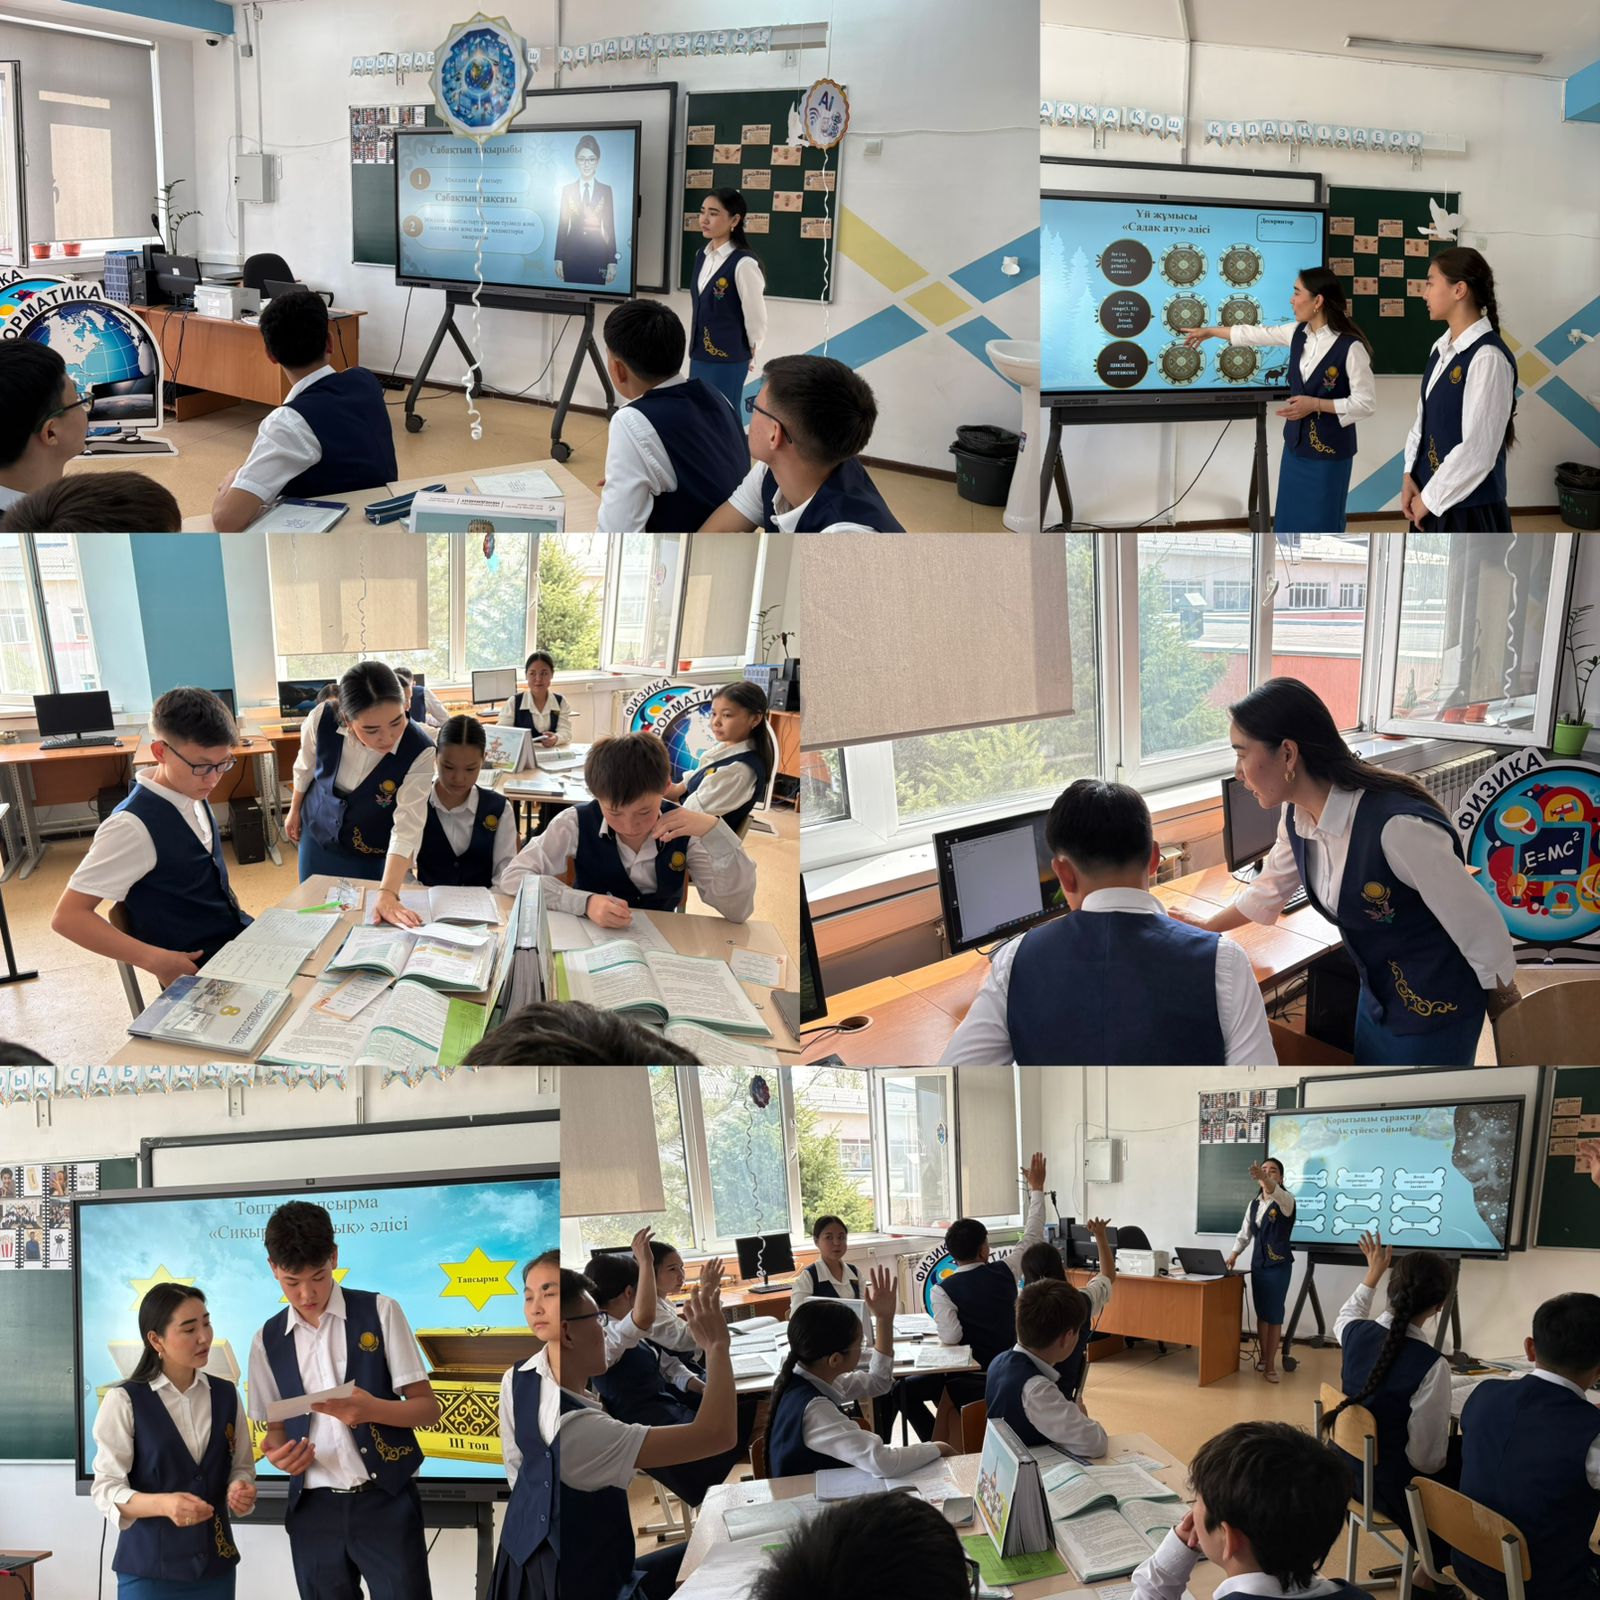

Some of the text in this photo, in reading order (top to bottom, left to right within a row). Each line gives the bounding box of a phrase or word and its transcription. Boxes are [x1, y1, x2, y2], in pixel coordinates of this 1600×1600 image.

[625, 679, 671, 717] ФИЗИКА
[1458, 752, 1543, 831] ФИЗИКА
[370, 1215, 408, 1233] әдісі
[916, 1244, 948, 1281] ФИЗИК
[457, 1275, 499, 1285] Тапсырма
[469, 1441, 489, 1451] топ
